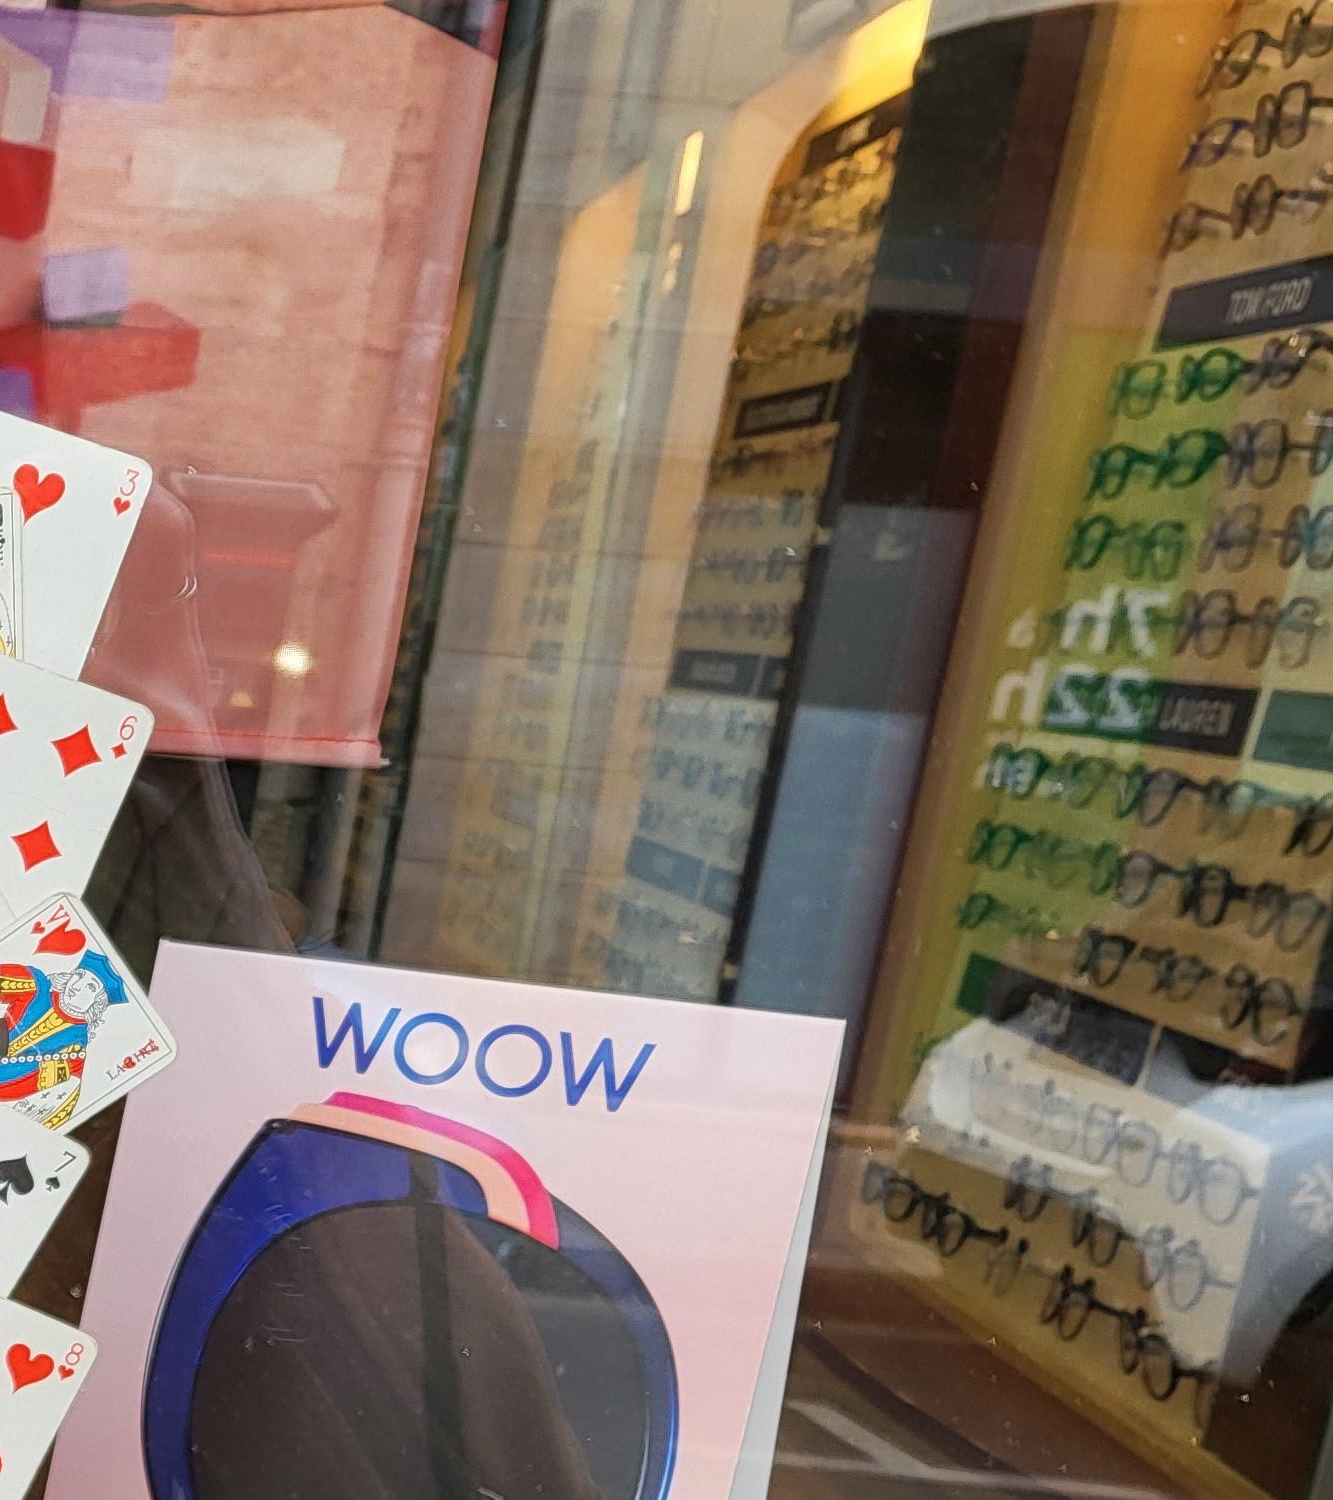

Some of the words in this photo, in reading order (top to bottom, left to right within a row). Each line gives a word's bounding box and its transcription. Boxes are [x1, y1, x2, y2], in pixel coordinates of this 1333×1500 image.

[119, 467, 140, 497] 3
[119, 715, 139, 742] 6
[313, 996, 657, 1113] WOOW
[53, 1151, 77, 1174] 7
[64, 1341, 86, 1367] 8
